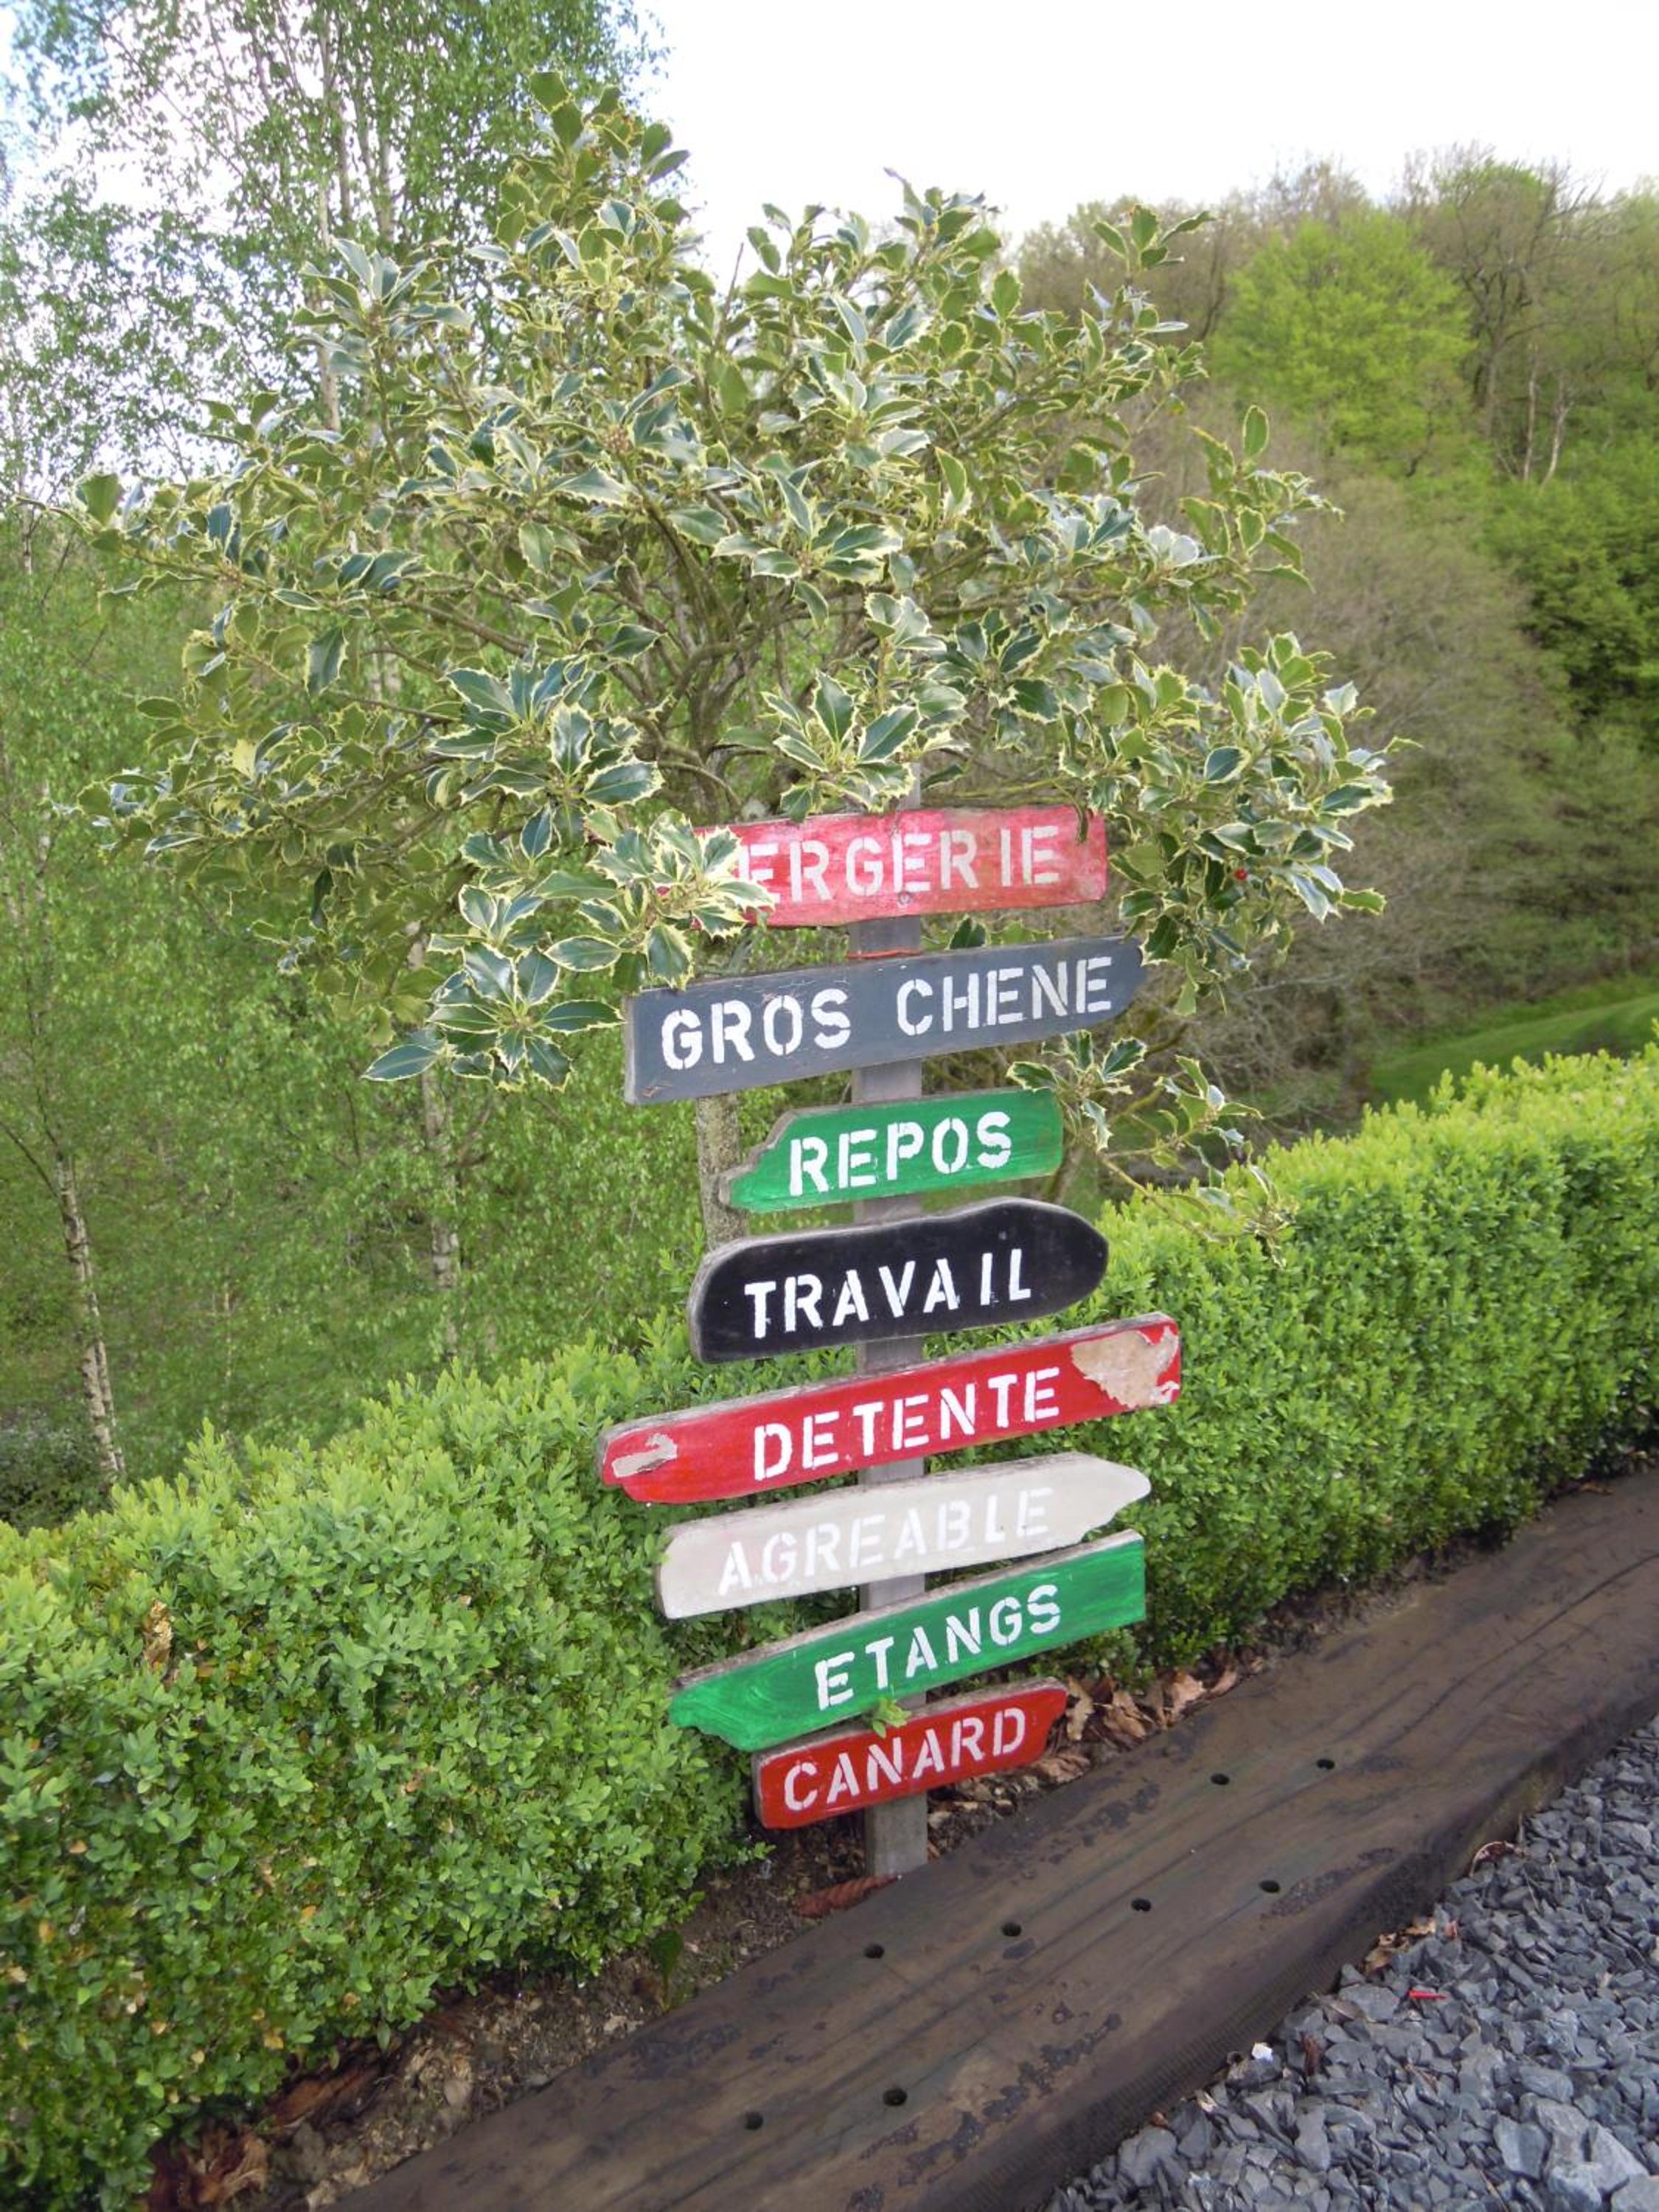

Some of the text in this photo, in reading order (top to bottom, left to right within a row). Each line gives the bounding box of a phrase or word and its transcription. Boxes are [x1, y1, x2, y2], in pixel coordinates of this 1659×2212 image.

[738, 825, 1060, 904] ERGERIE
[661, 956, 1112, 1071] GROS CHENE
[789, 1111, 1011, 1196] REPOS
[745, 1248, 1031, 1339] TRAVAIL
[754, 1367, 1060, 1480] DETENTE
[718, 1487, 1053, 1596] AGREABLE
[815, 1585, 1061, 1711] ETANGS
[783, 1708, 1026, 1813] CANARD
